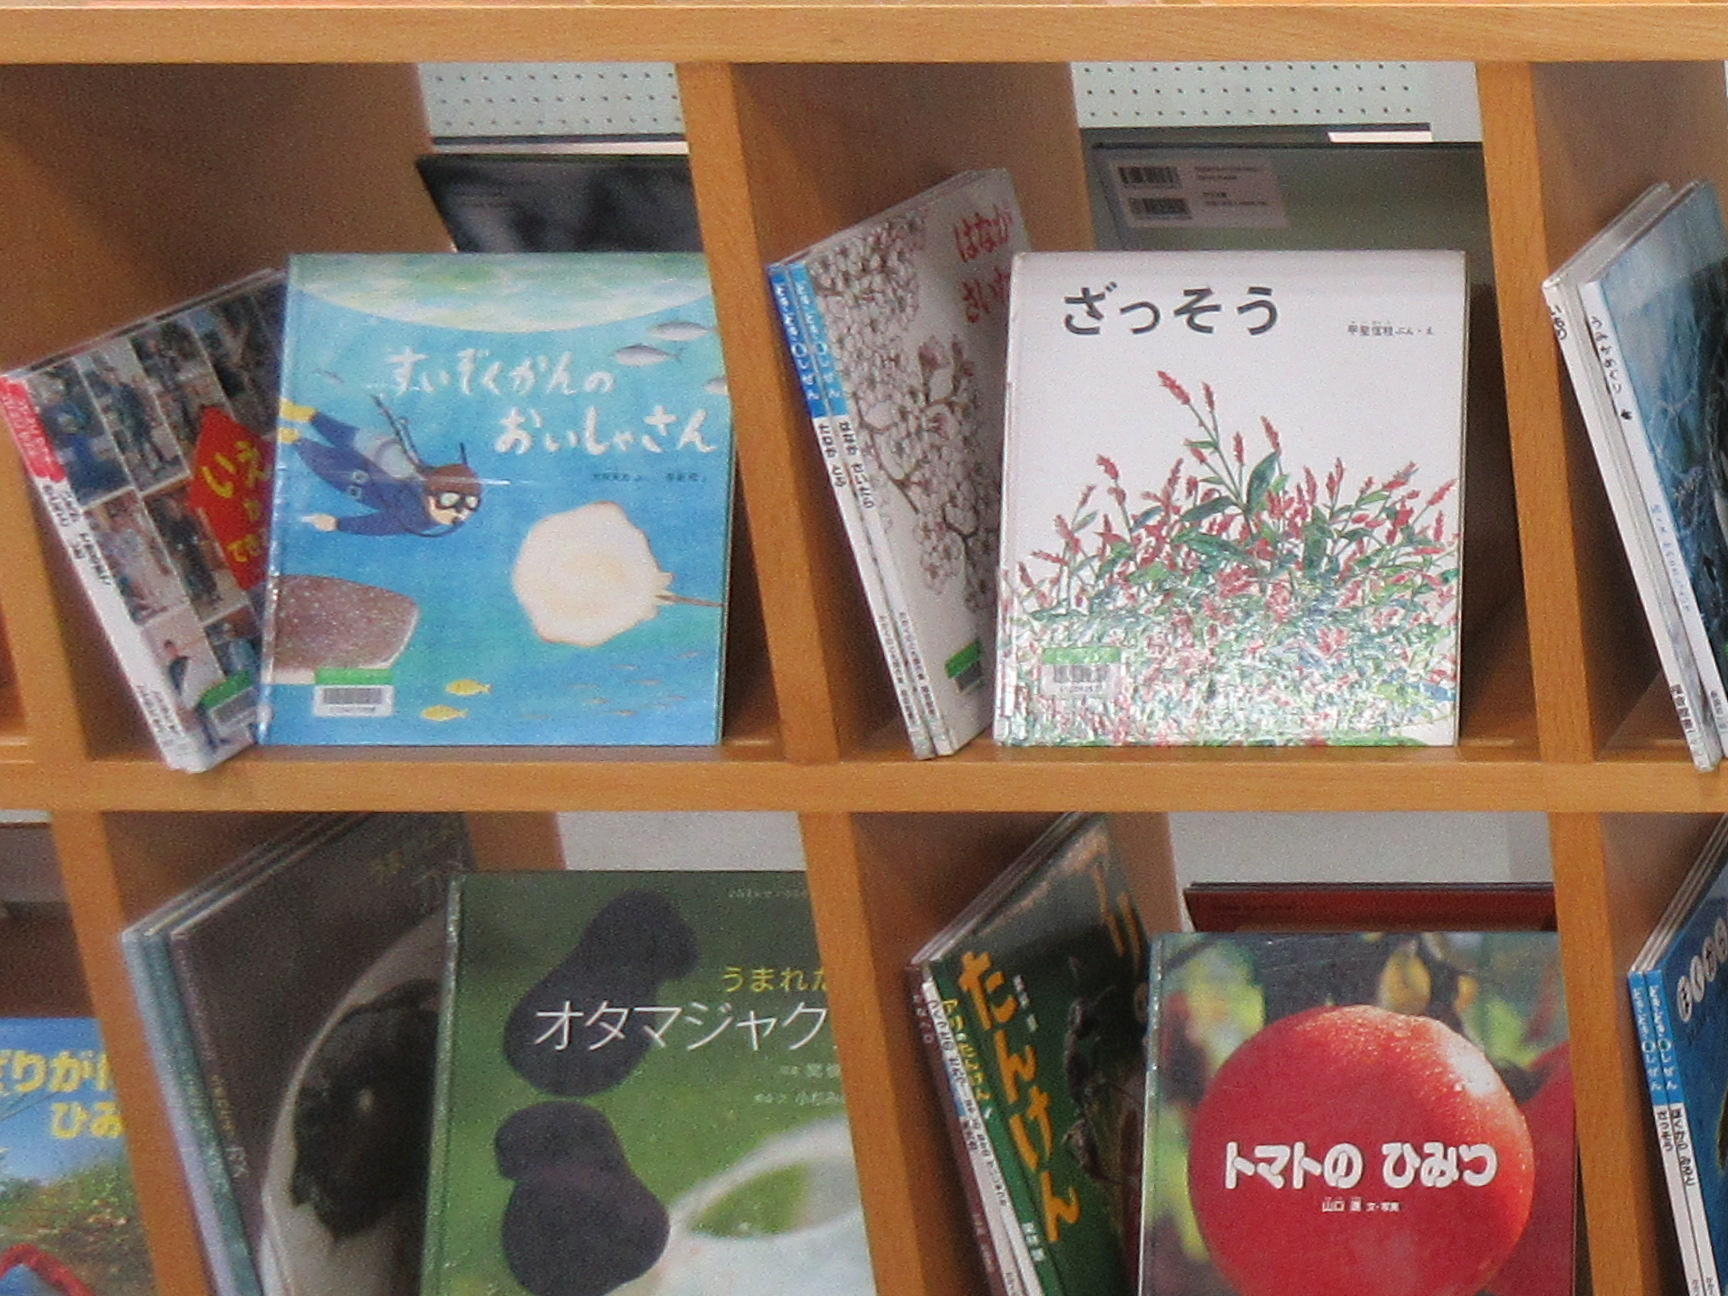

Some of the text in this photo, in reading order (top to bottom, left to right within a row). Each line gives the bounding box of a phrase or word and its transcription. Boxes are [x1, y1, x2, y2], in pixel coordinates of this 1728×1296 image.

[1062, 282, 1280, 335] ざっそう
[384, 346, 614, 396] すいぞくかんの
[494, 407, 717, 456] おいしゃさん
[535, 1001, 828, 1052] オタマジャク
[957, 949, 1081, 1244] たんけん
[1224, 1141, 1498, 1189] トマトの ひみつ
